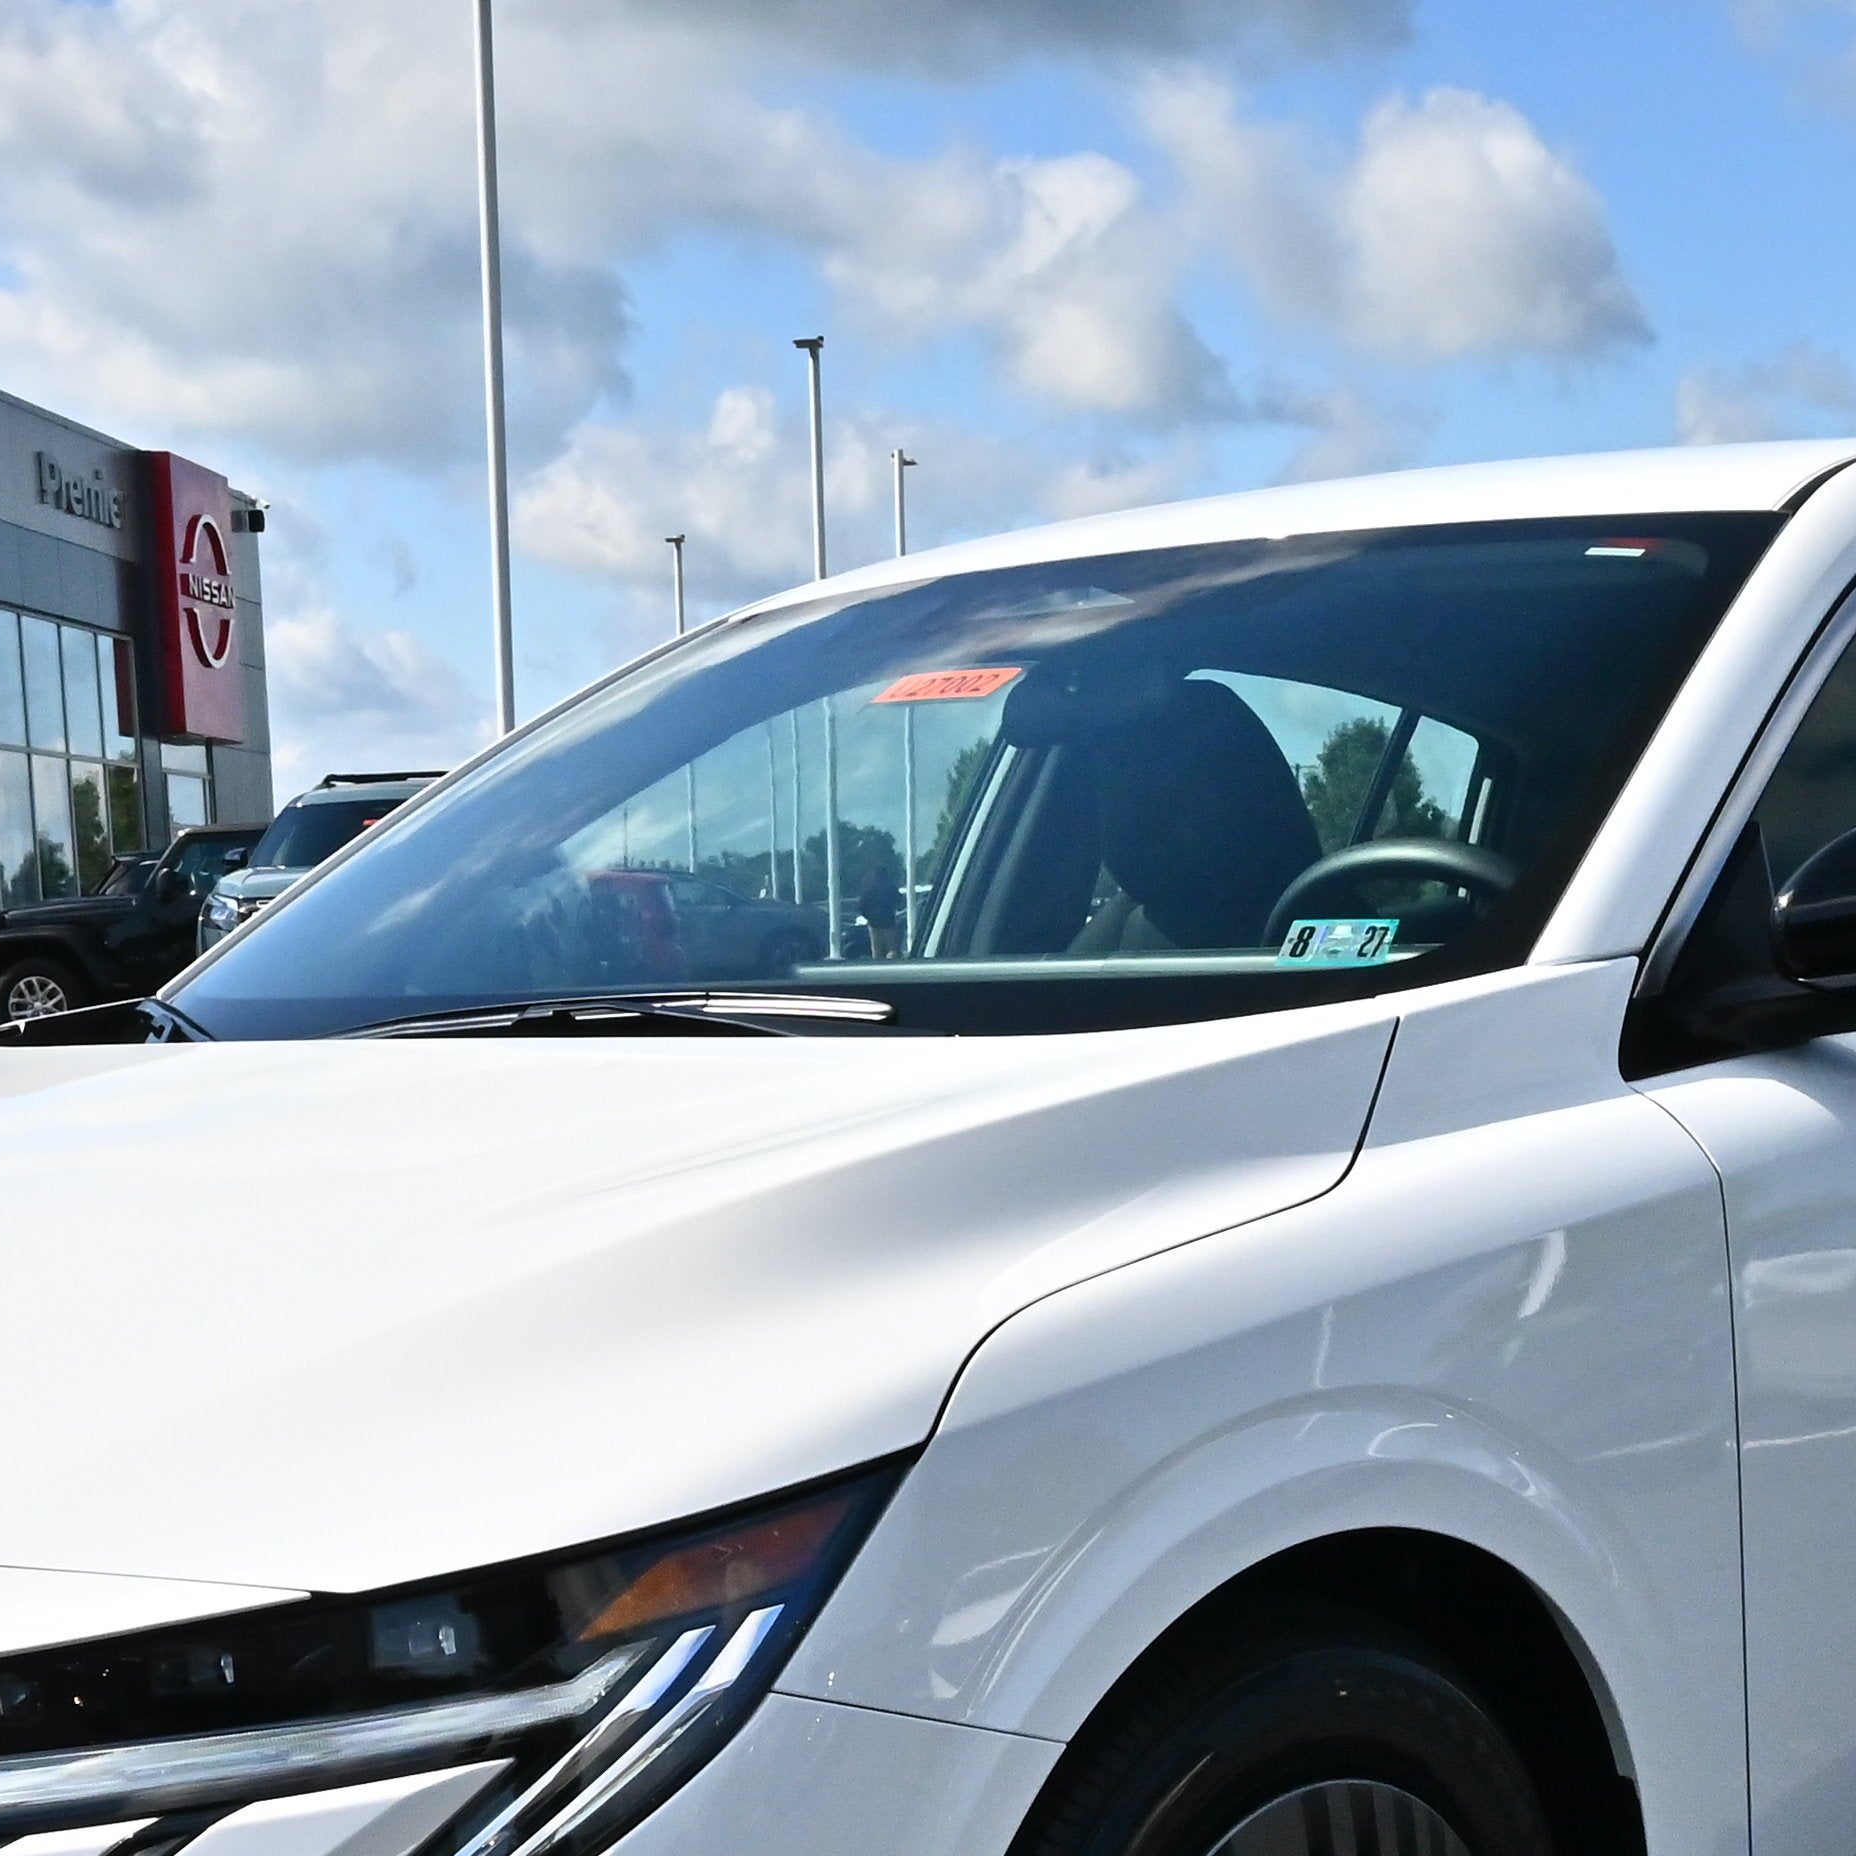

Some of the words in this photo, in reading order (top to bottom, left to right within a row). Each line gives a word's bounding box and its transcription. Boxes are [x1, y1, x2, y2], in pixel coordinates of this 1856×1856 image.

[37, 451, 124, 529] Premie
[188, 573, 235, 609] NISSAN
[1289, 926, 1316, 958] 8
[1357, 925, 1390, 958] 27
